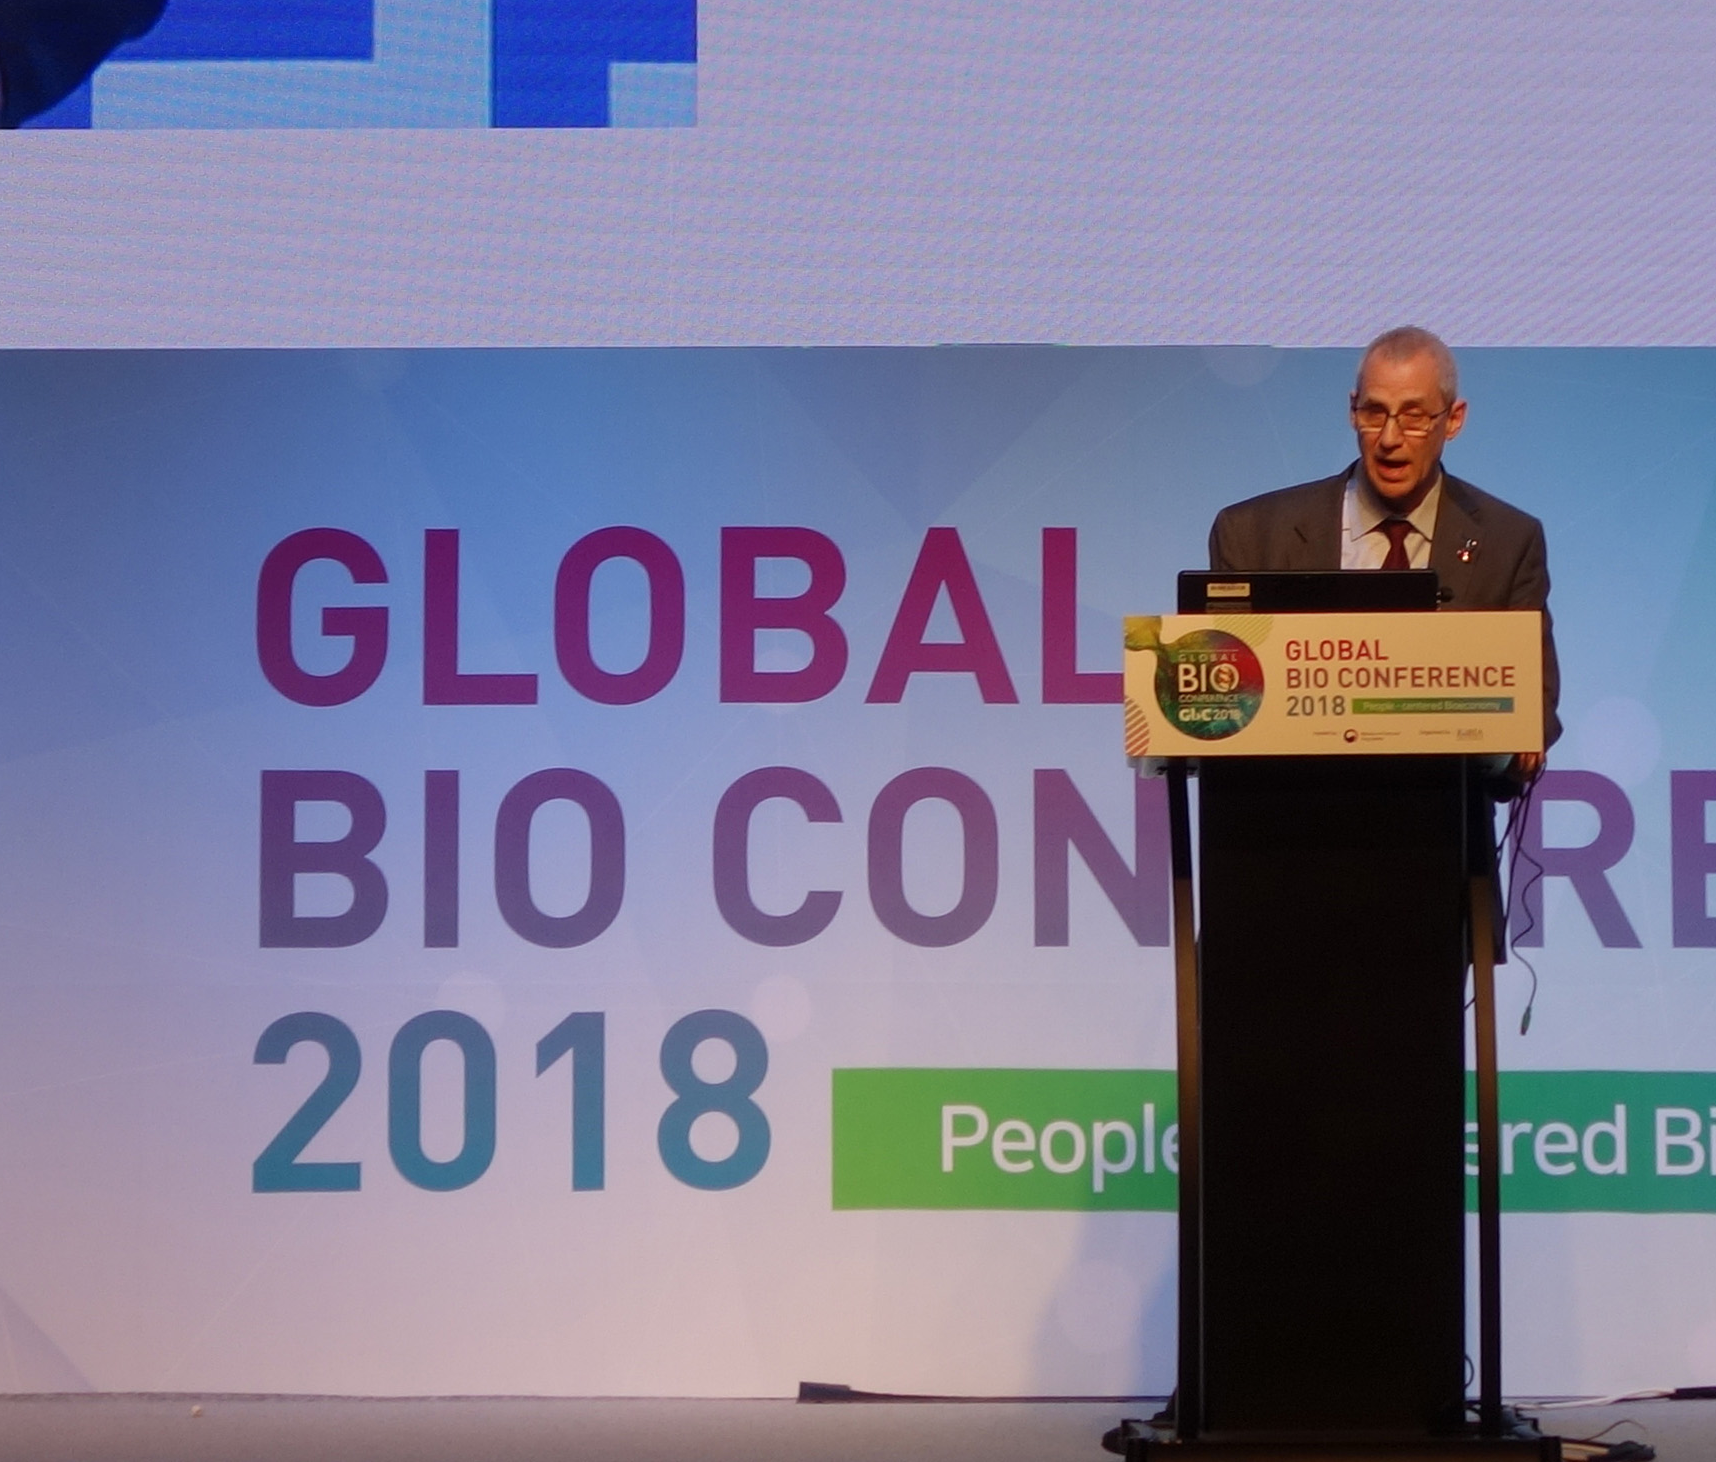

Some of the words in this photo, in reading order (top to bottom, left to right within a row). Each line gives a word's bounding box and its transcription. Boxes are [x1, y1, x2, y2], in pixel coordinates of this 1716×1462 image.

[254, 524, 1124, 707] GLOBAL
[1285, 639, 1389, 662] GLOBAL
[1178, 663, 1240, 693] BIO
[1286, 667, 1329, 690] BIO
[1337, 665, 1516, 689] CONFERENCE
[1286, 695, 1346, 717] 2018
[259, 767, 626, 948] BIO
[252, 1010, 771, 1194] 2018
